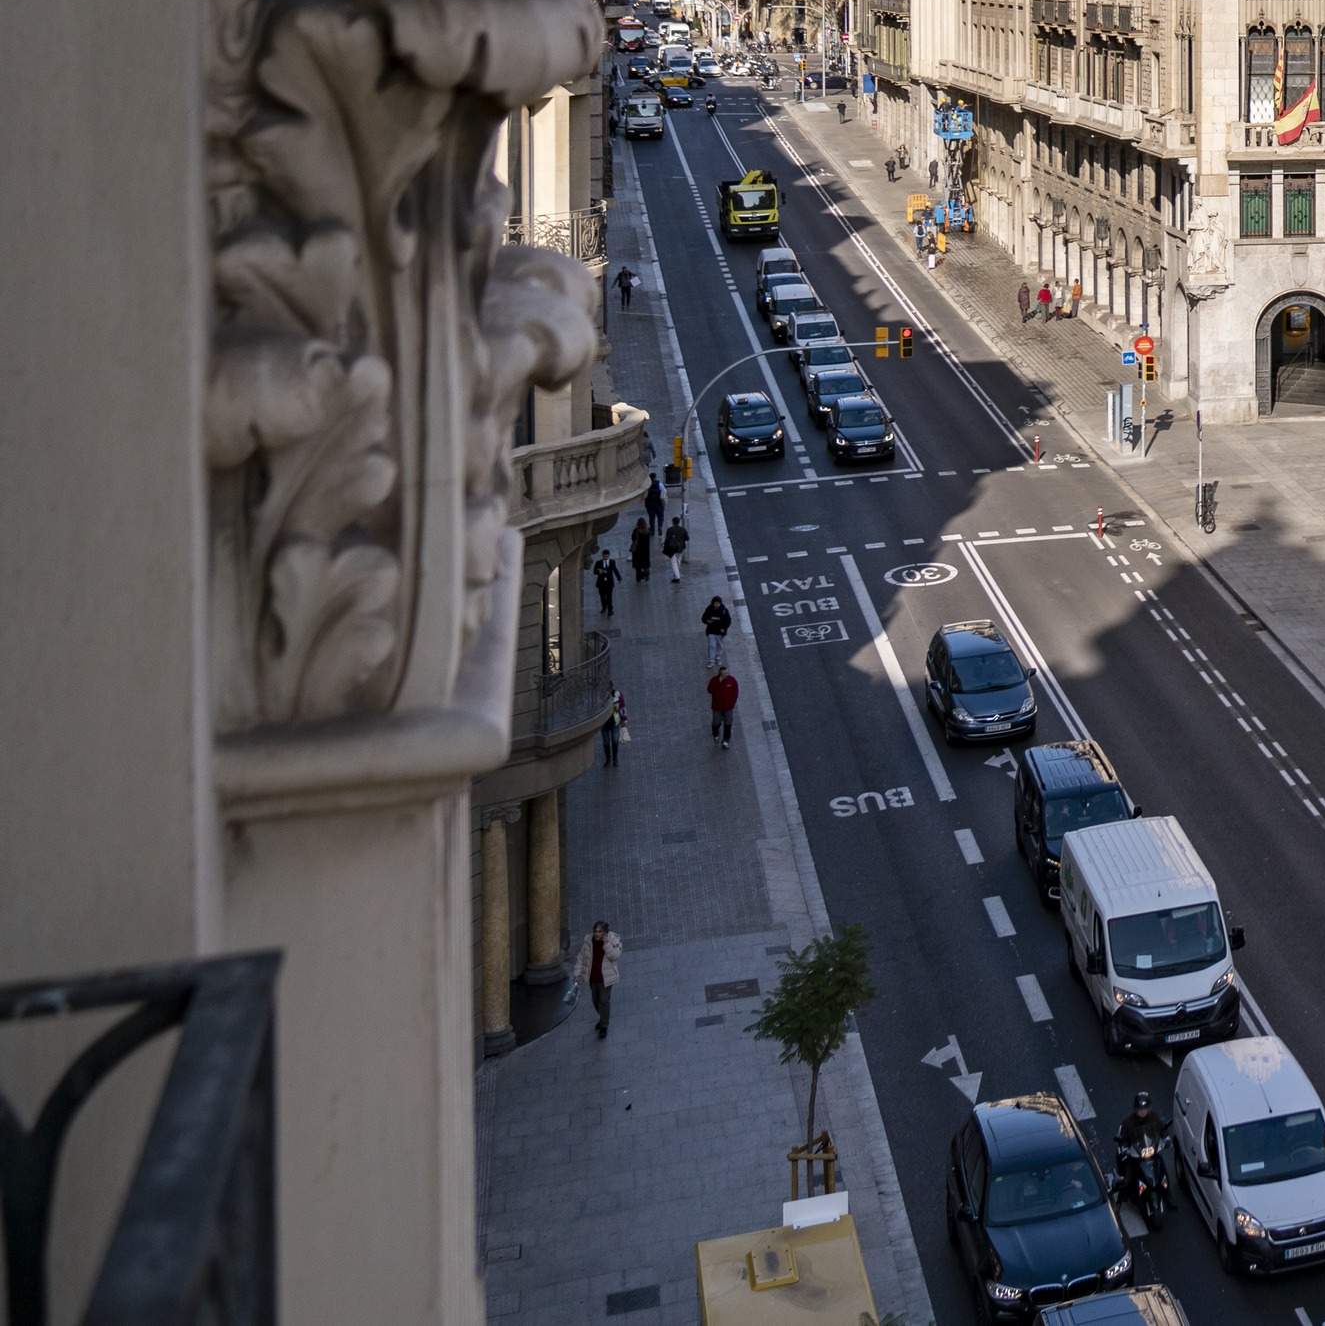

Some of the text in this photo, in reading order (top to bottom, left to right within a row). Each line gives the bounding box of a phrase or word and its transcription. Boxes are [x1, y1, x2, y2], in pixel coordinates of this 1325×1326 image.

[902, 567, 941, 582] 30
[760, 575, 835, 595] TAXI
[772, 597, 840, 616] BUS
[829, 786, 916, 817] BUS
